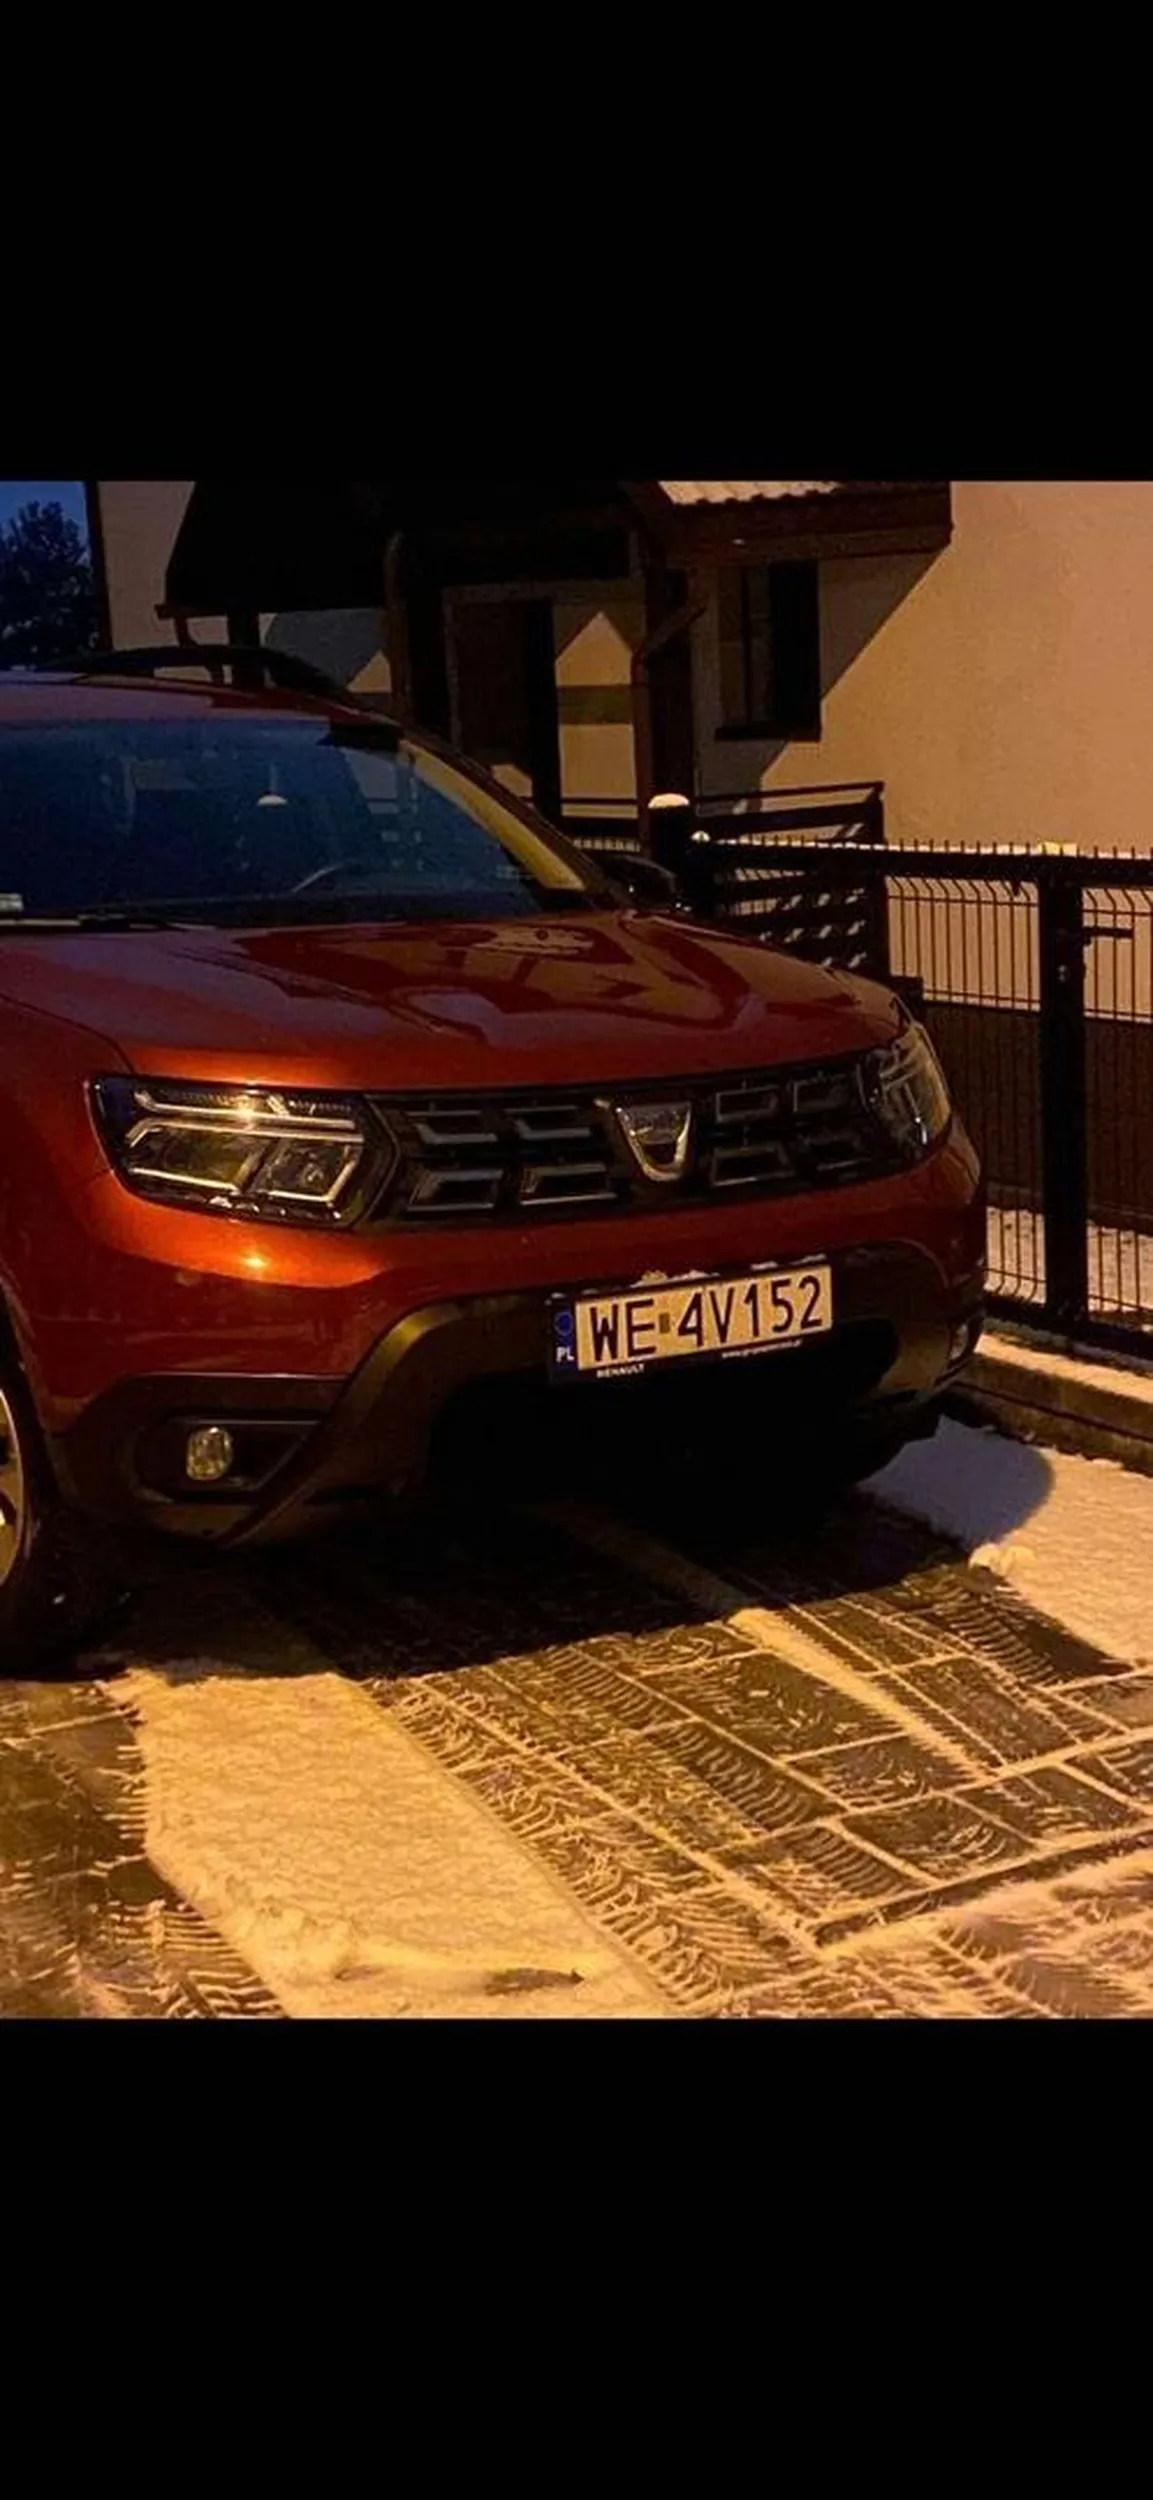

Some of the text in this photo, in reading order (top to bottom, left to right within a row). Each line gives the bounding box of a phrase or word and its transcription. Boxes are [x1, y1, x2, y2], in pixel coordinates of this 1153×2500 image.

[589, 1275, 822, 1362] WE 4V152
[556, 1346, 575, 1362] PL
[597, 1363, 645, 1378] RENAULT
